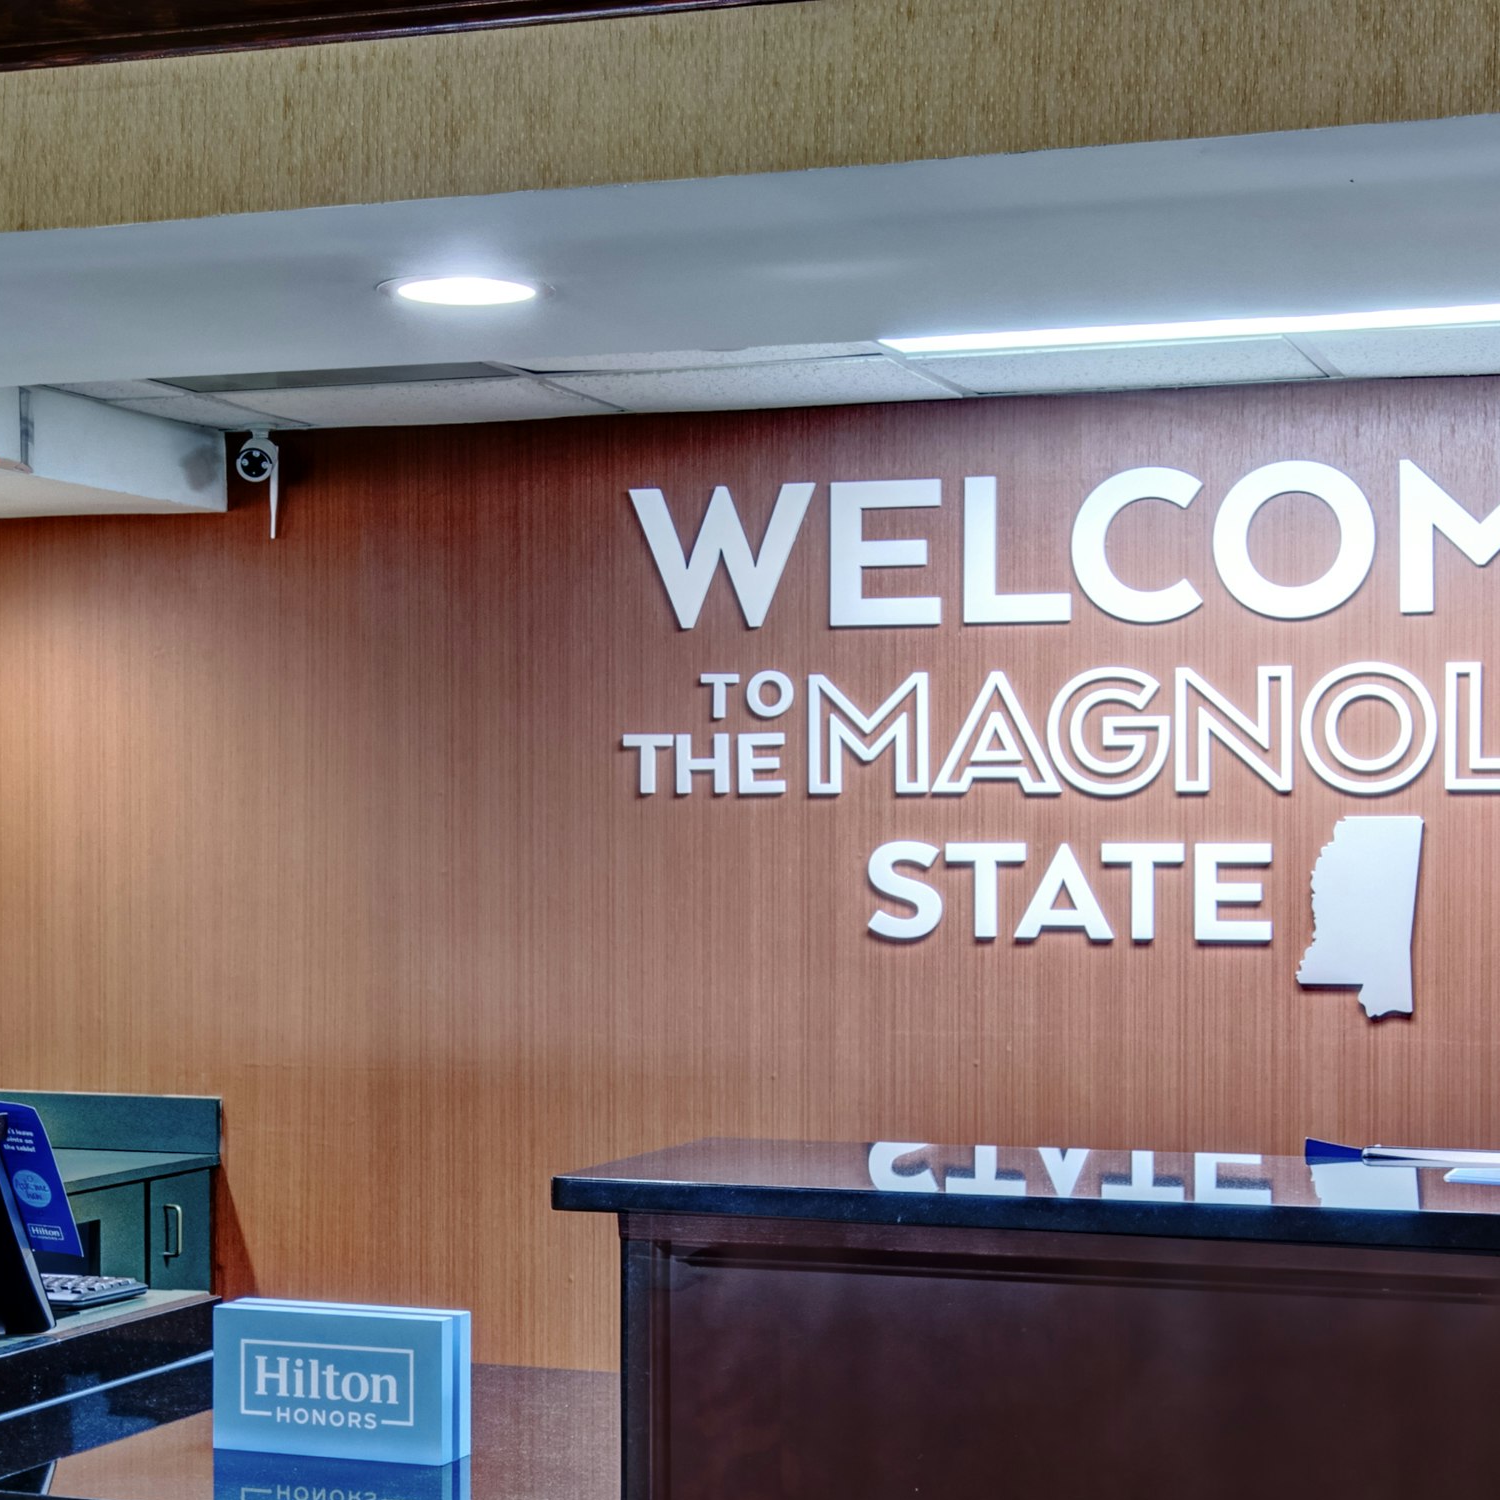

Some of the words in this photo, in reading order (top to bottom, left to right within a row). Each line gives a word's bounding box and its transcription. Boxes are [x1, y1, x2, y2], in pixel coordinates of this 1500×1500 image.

[700, 671, 794, 719] TO
[623, 732, 787, 795] THE
[868, 840, 1273, 943] STATE
[31, 1226, 60, 1237] Hilton
[255, 1355, 399, 1405] Hilton
[276, 1407, 377, 1429] HONORS
